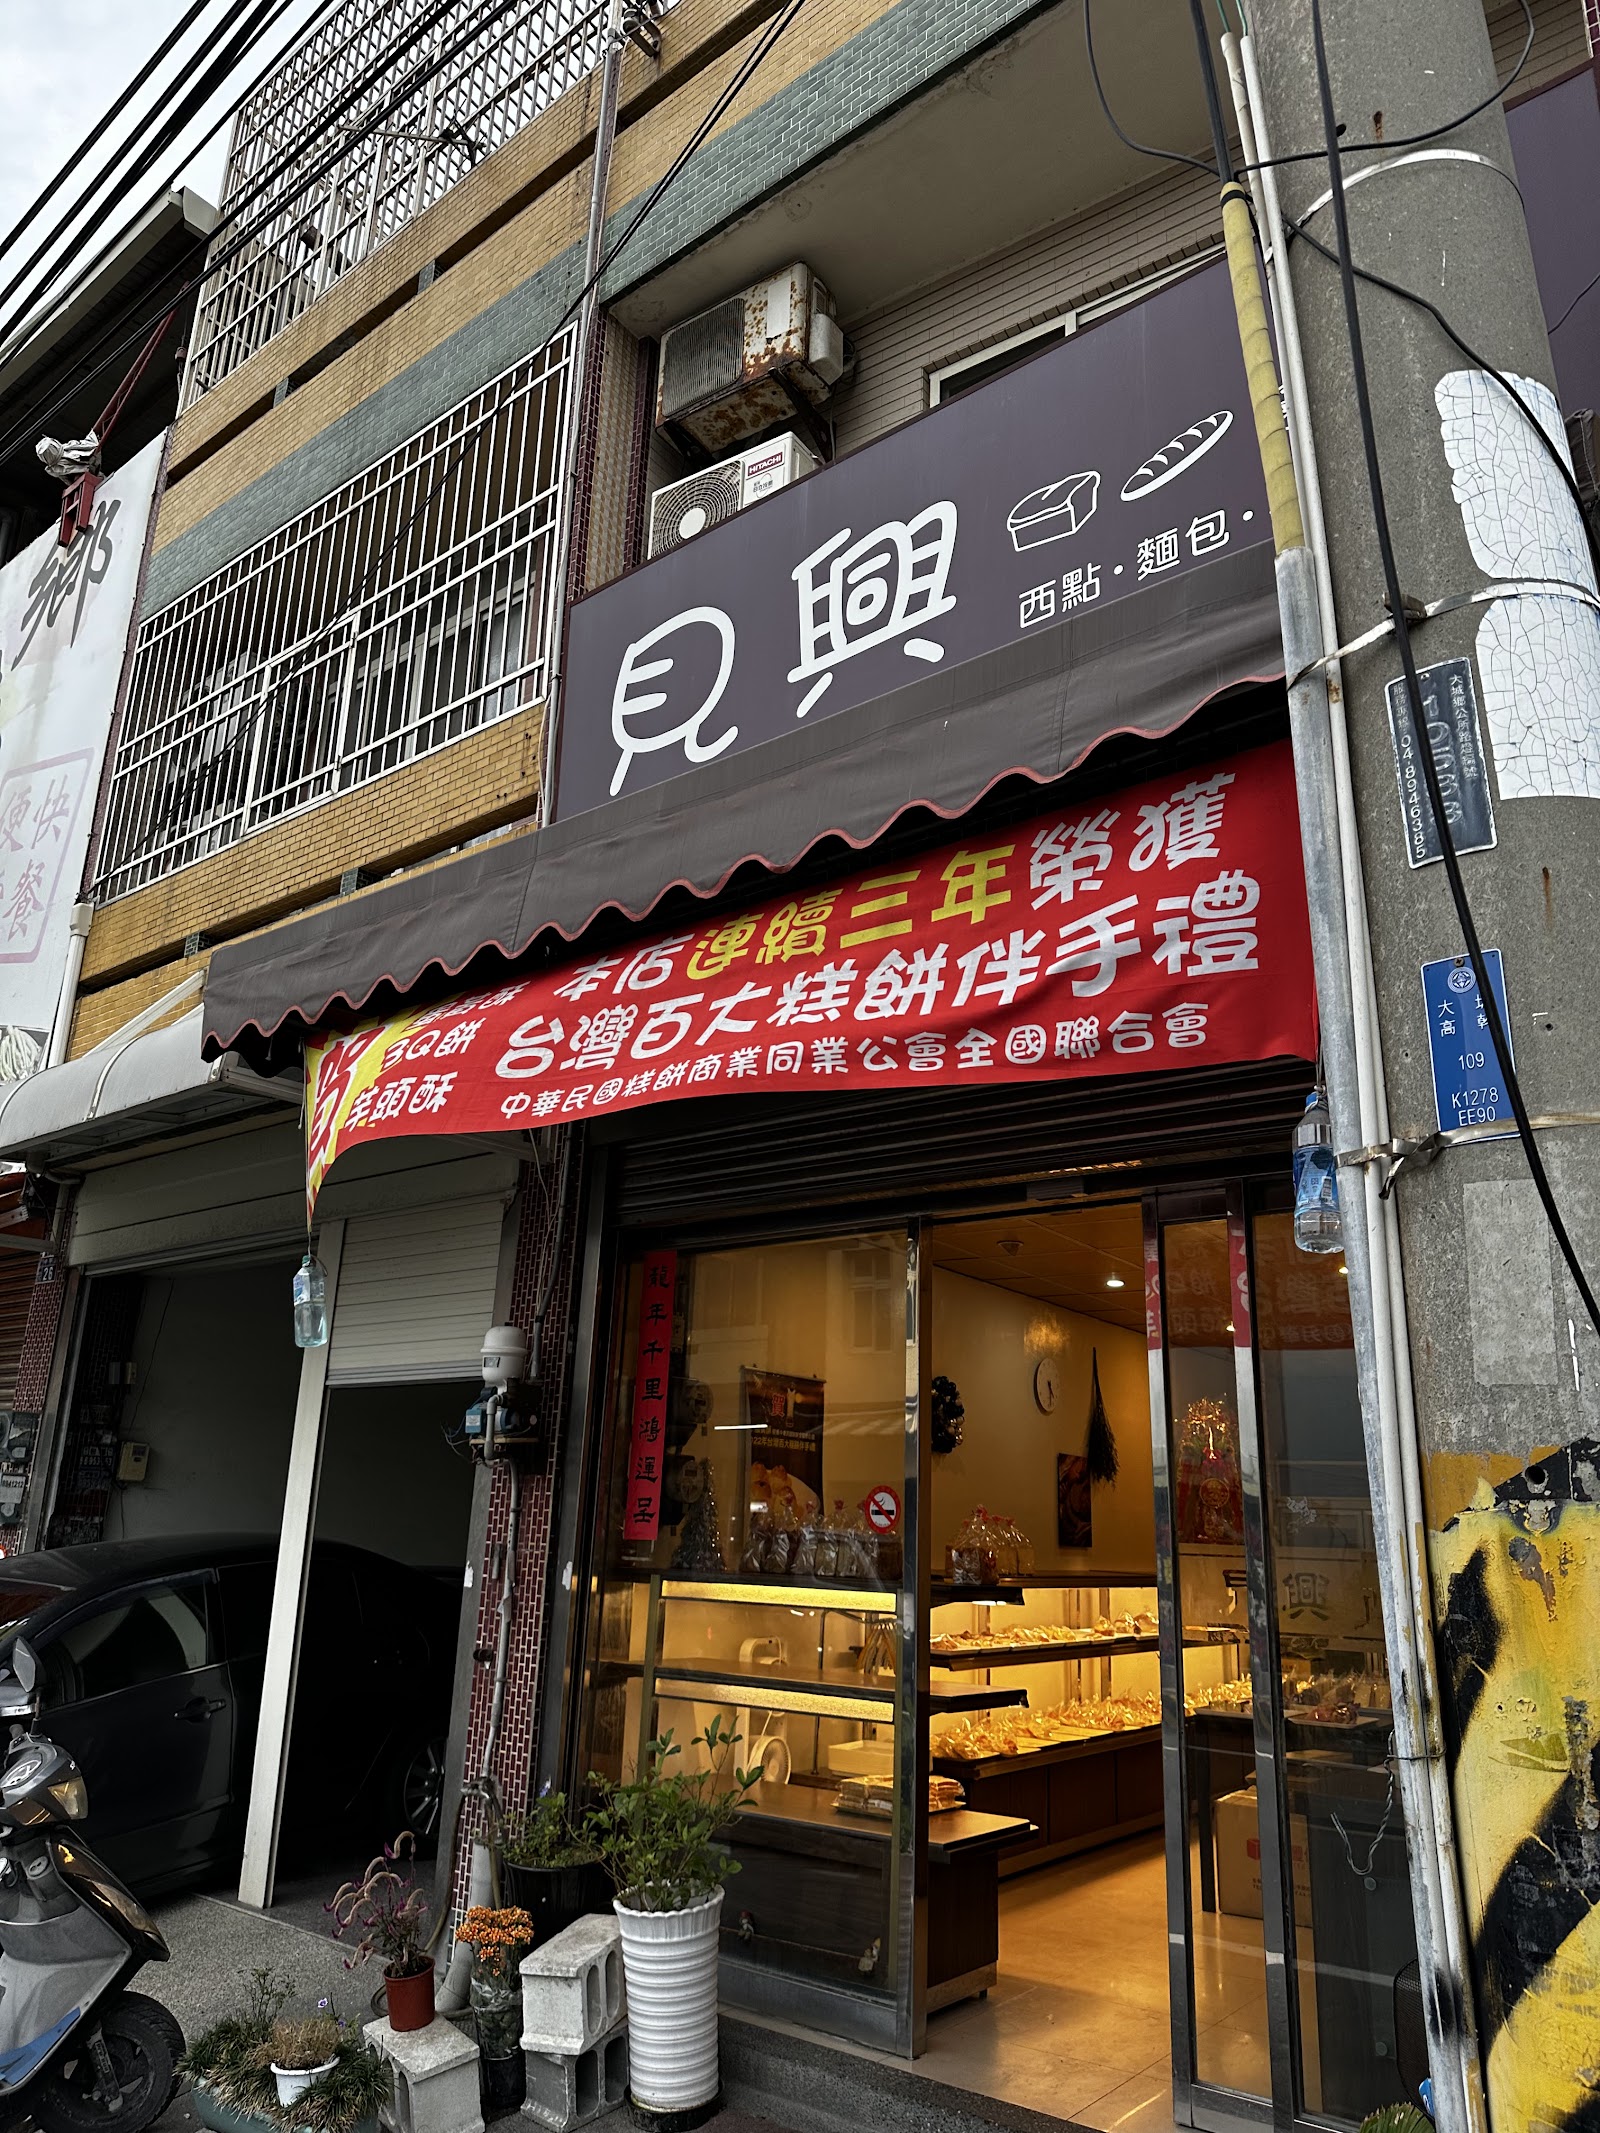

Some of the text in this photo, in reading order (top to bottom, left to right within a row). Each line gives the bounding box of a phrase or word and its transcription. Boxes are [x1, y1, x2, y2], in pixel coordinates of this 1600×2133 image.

[749, 454, 782, 474] HITACHI
[609, 500, 958, 797] 貝興
[553, 772, 1236, 1002] 本店連續三年榮獲
[495, 869, 1261, 1079] 台灣百大糕餅伴手禮
[384, 1017, 487, 1069] 3Q餅
[500, 1002, 1210, 1120] 中華民國糕餅商業同業公會全國聯合會
[1458, 1051, 1485, 1070] 109
[345, 1071, 459, 1132] 芋頭酥
[1451, 1086, 1499, 1109] K1278
[1458, 1105, 1496, 1127] EE90
[42, 1266, 54, 1281] 26
[632, 1263, 671, 1525] 龍年千里鴻運呈
